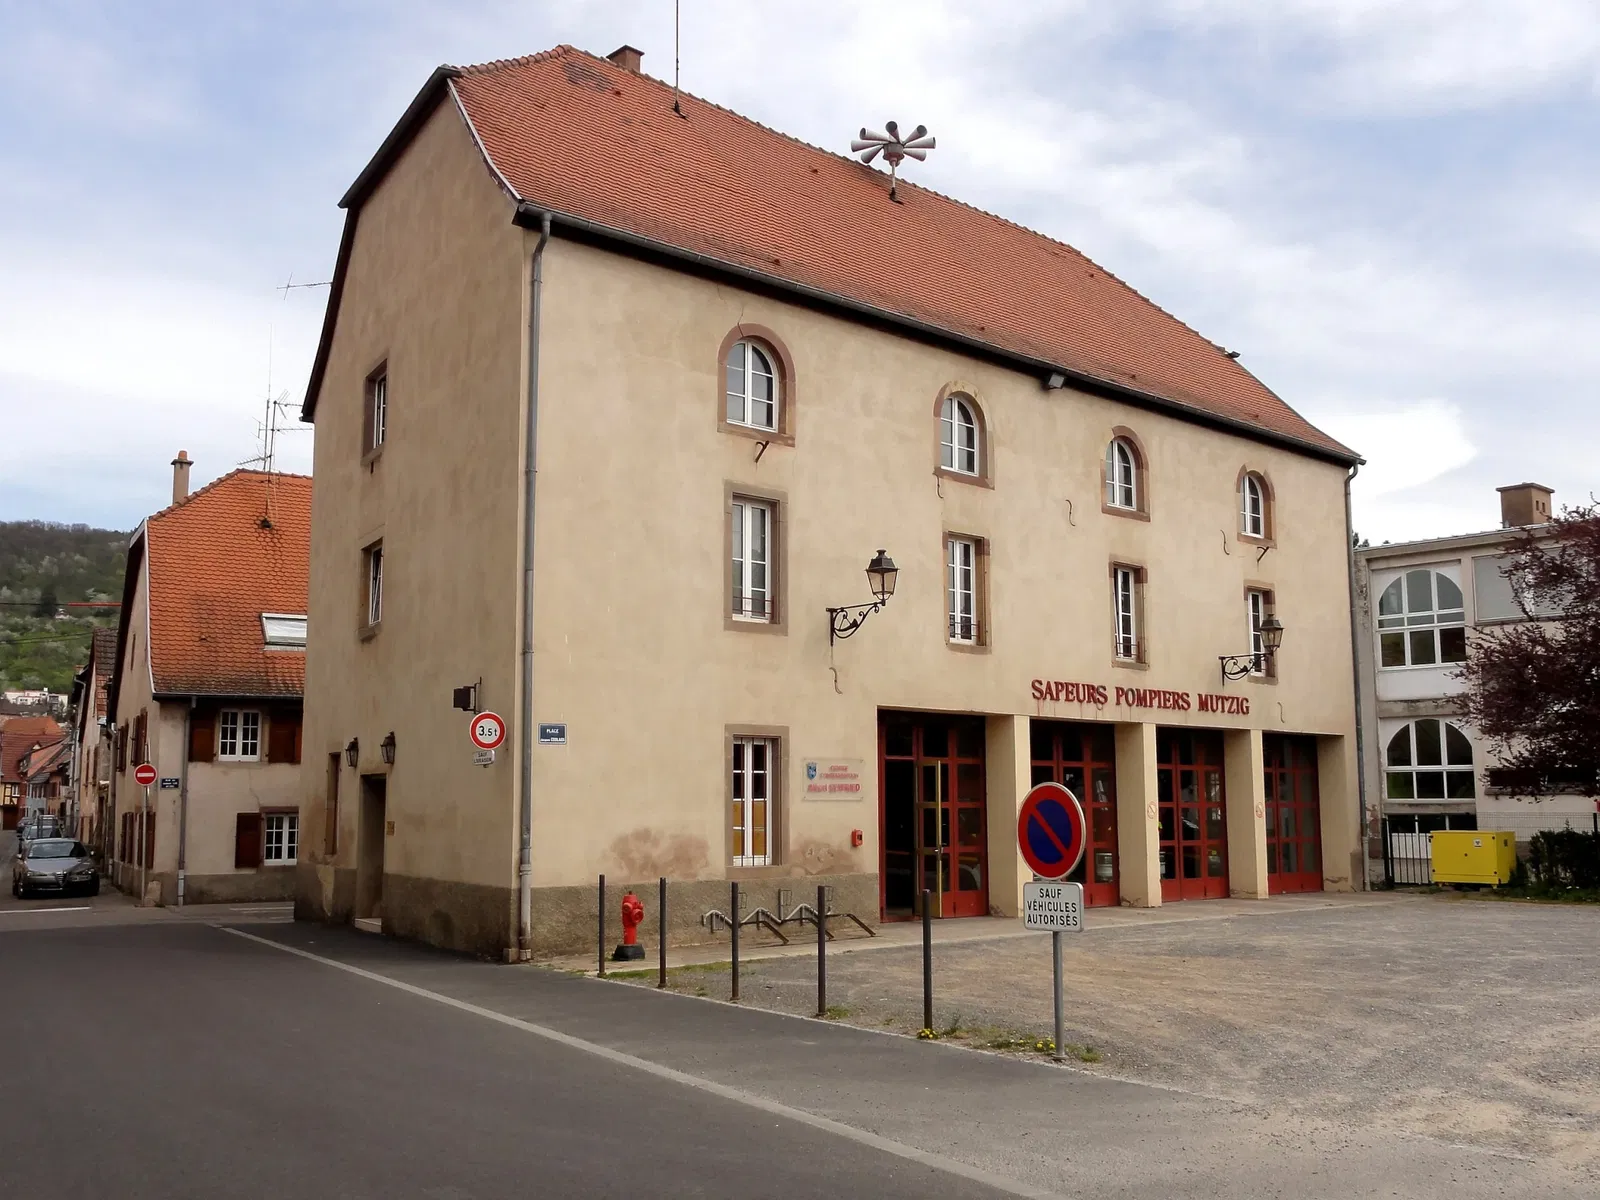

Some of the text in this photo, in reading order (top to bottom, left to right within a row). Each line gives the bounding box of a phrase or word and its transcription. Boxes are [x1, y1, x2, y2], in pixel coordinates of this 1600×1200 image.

[1031, 679, 1250, 715] SAPEURS POMPIERS MUTZIG
[1039, 888, 1062, 899] SAUF
[1027, 899, 1077, 913] VÉHICULES
[1027, 913, 1078, 926] AUTORISÉS
